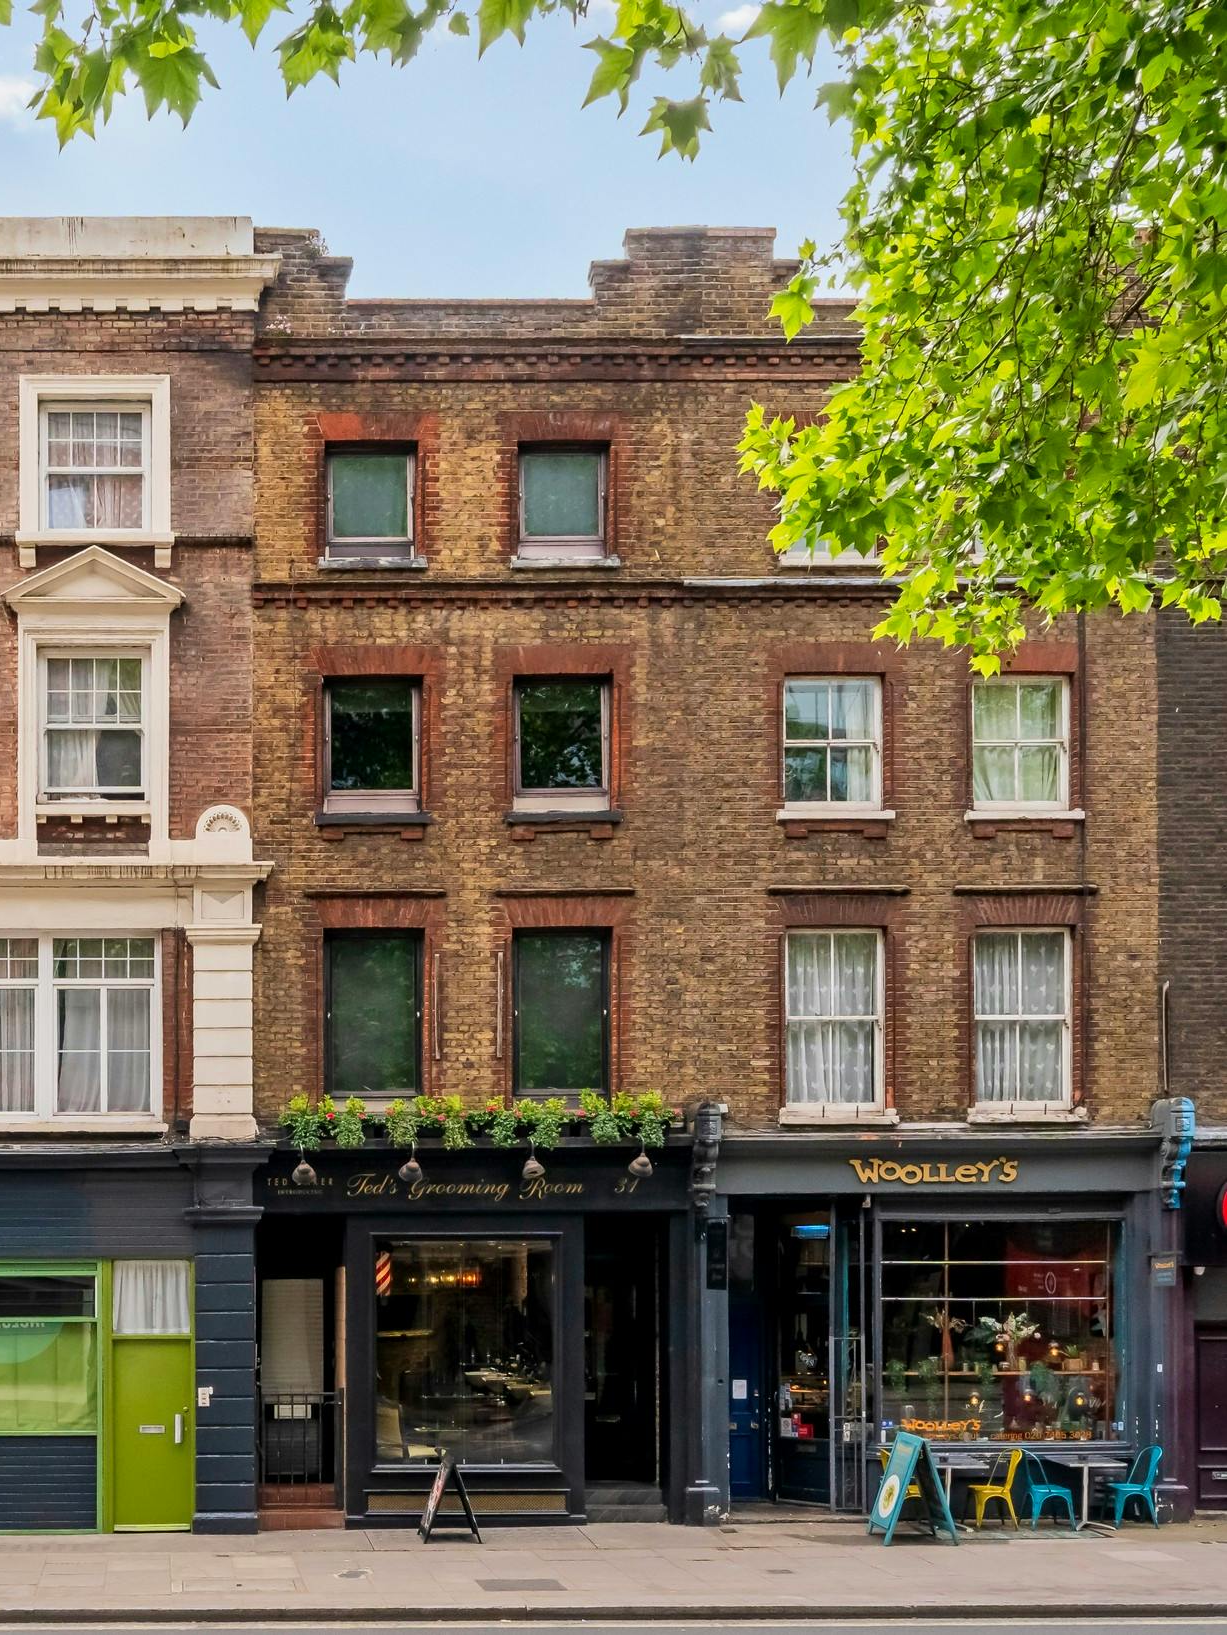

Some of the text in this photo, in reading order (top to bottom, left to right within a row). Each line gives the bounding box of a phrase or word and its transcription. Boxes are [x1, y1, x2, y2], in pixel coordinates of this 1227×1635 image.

[267, 1177, 288, 1186] TED
[346, 1173, 641, 1201] Ted's Grooming Room 31
